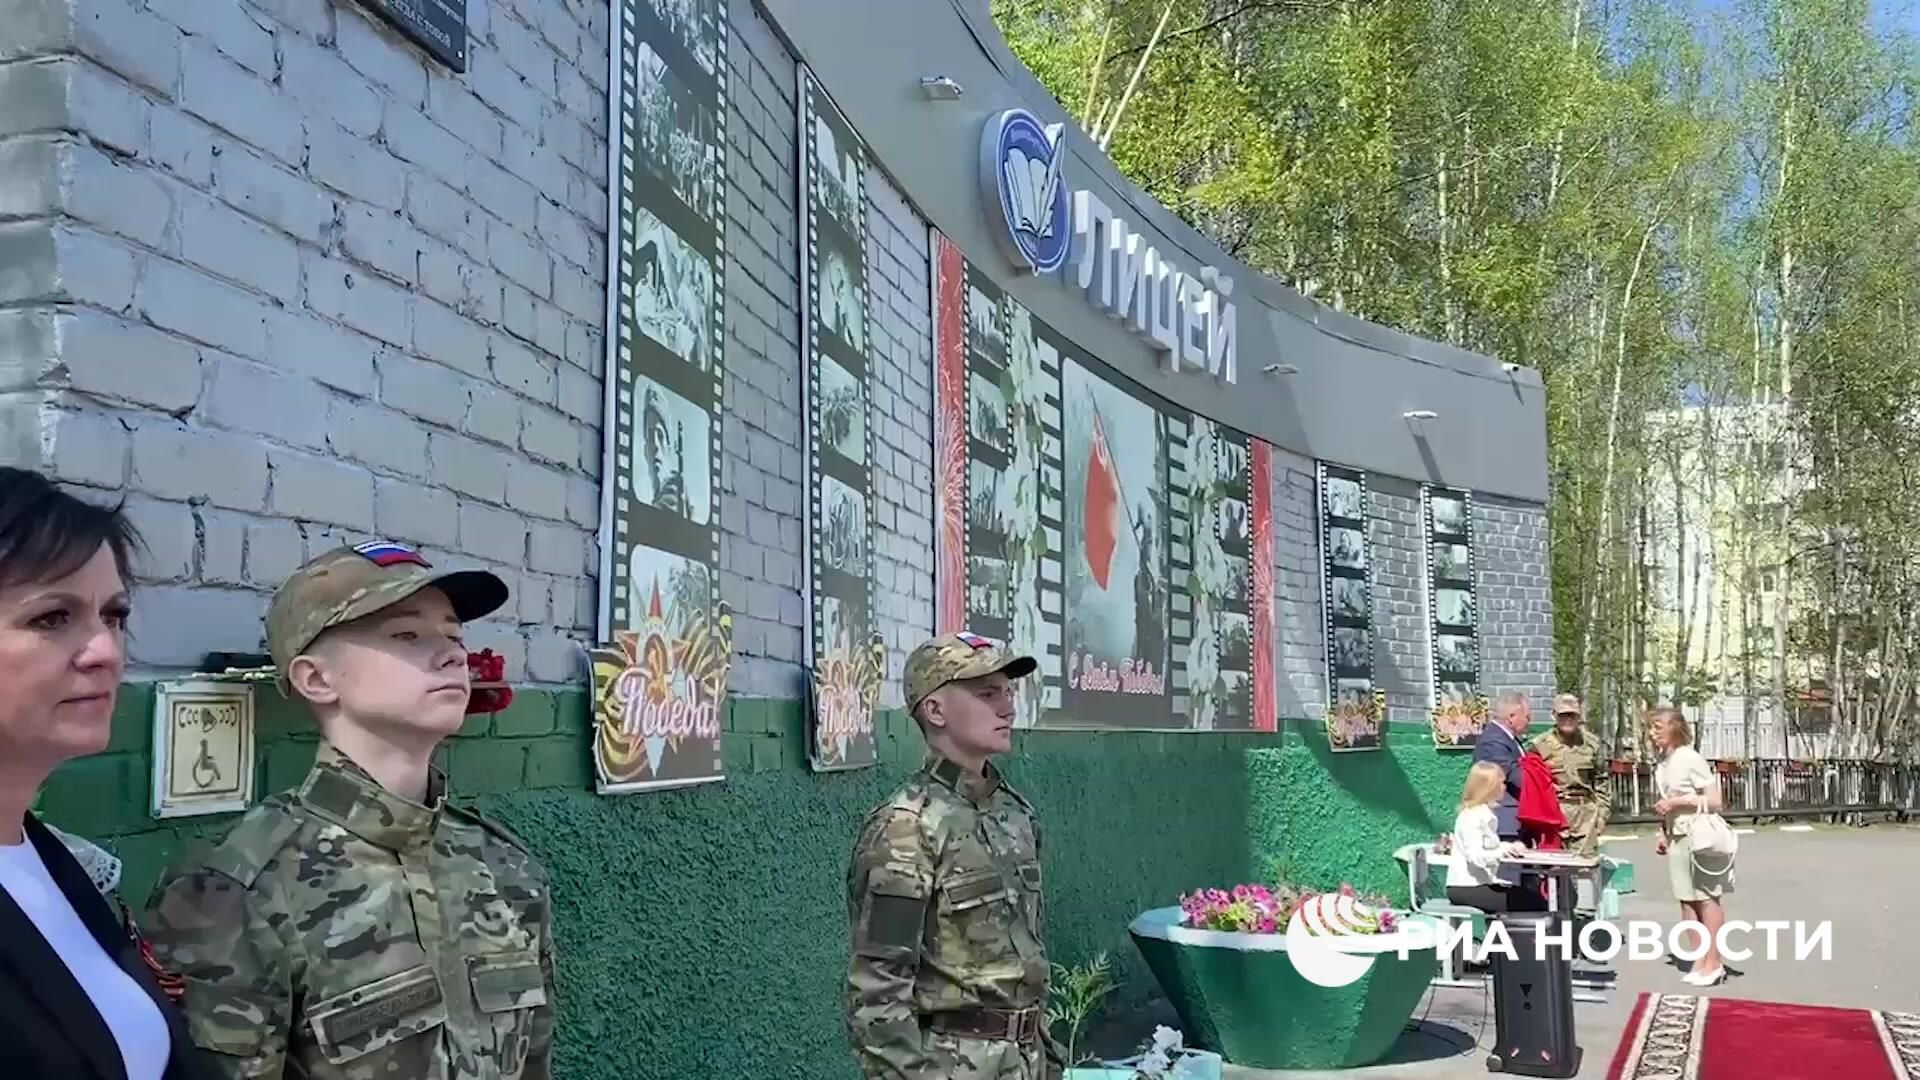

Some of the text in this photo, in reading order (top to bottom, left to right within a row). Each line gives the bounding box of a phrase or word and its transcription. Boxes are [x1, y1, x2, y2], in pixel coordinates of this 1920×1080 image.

[1075, 189, 1237, 385] ЛИЦЕЙ
[614, 666, 720, 738] Победа!
[1067, 651, 1079, 690] С
